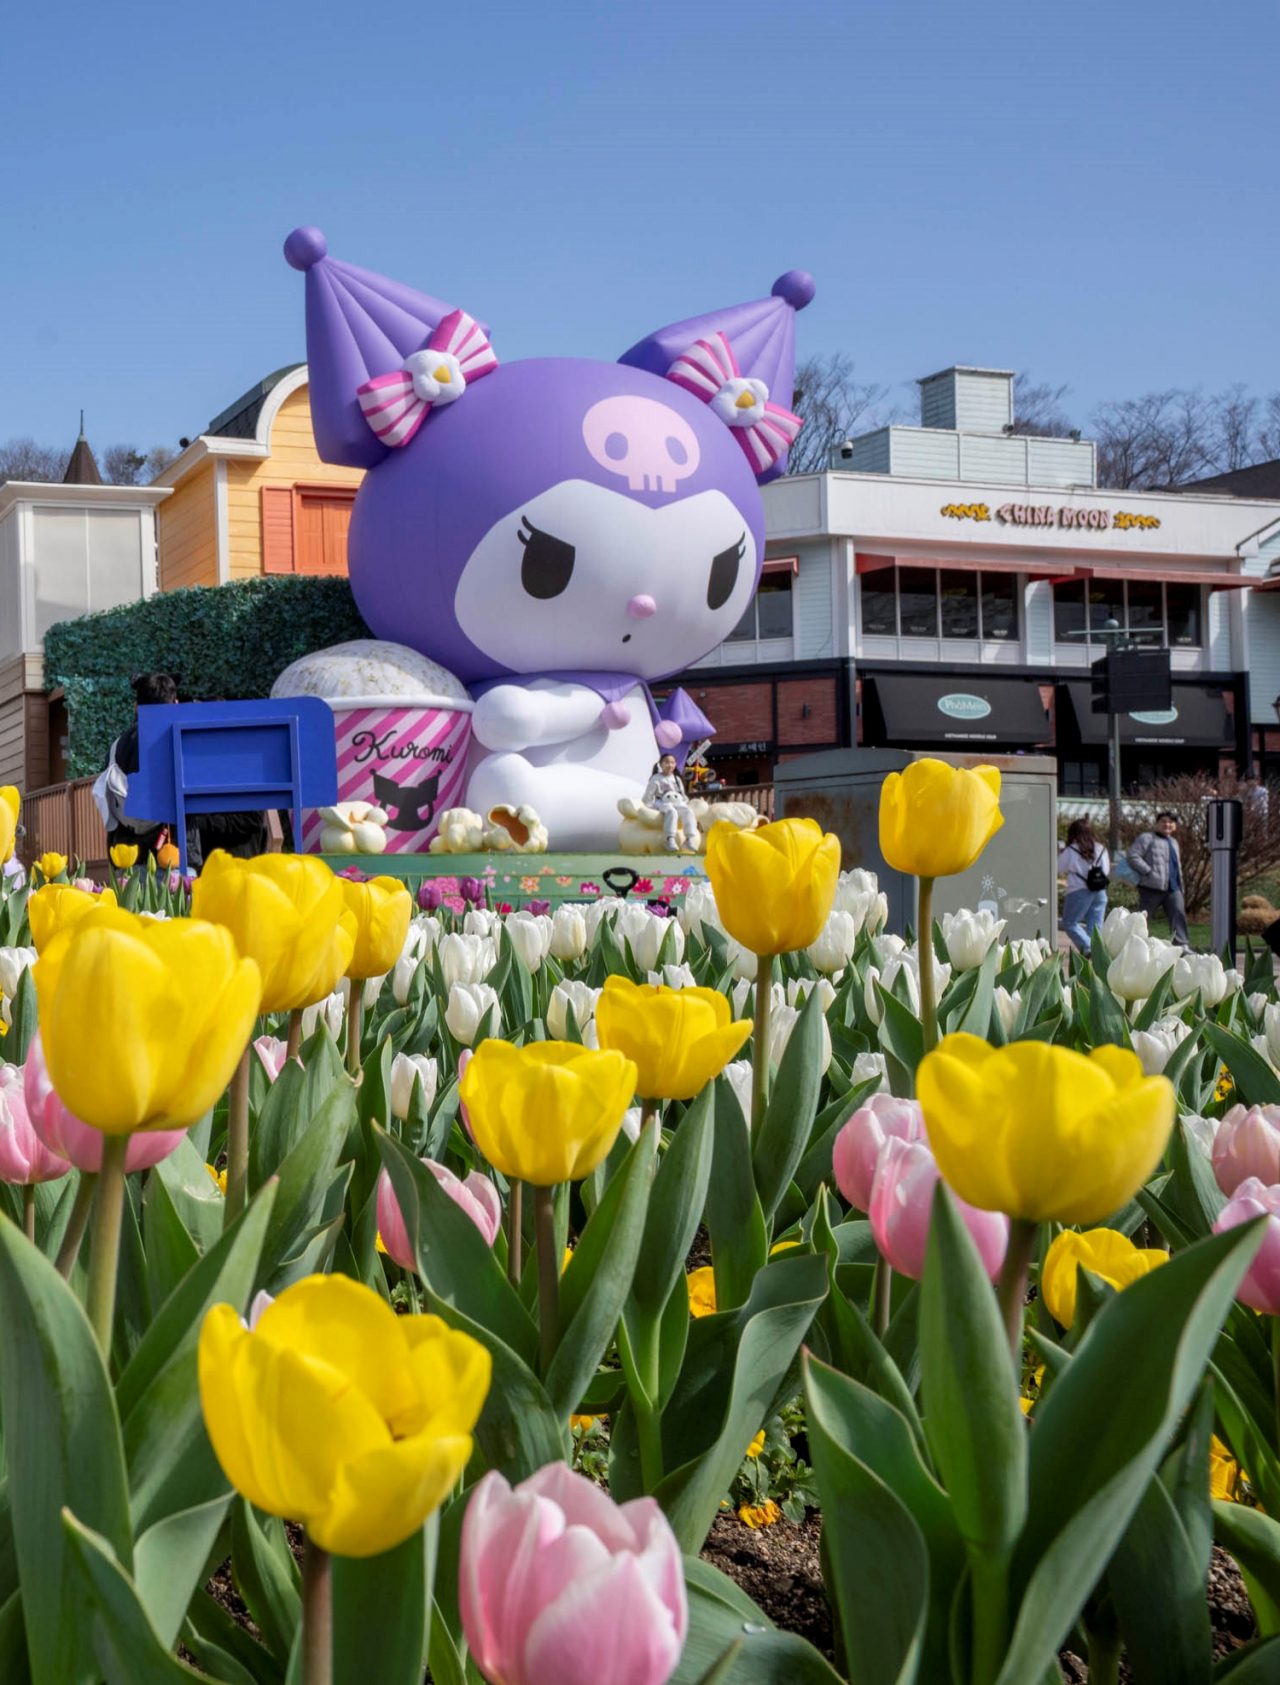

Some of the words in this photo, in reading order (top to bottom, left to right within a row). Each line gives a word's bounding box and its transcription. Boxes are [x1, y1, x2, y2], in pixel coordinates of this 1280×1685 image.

[996, 504, 1056, 526] CHINA
[1058, 506, 1110, 529] MOON
[352, 729, 453, 764] Kuromi
